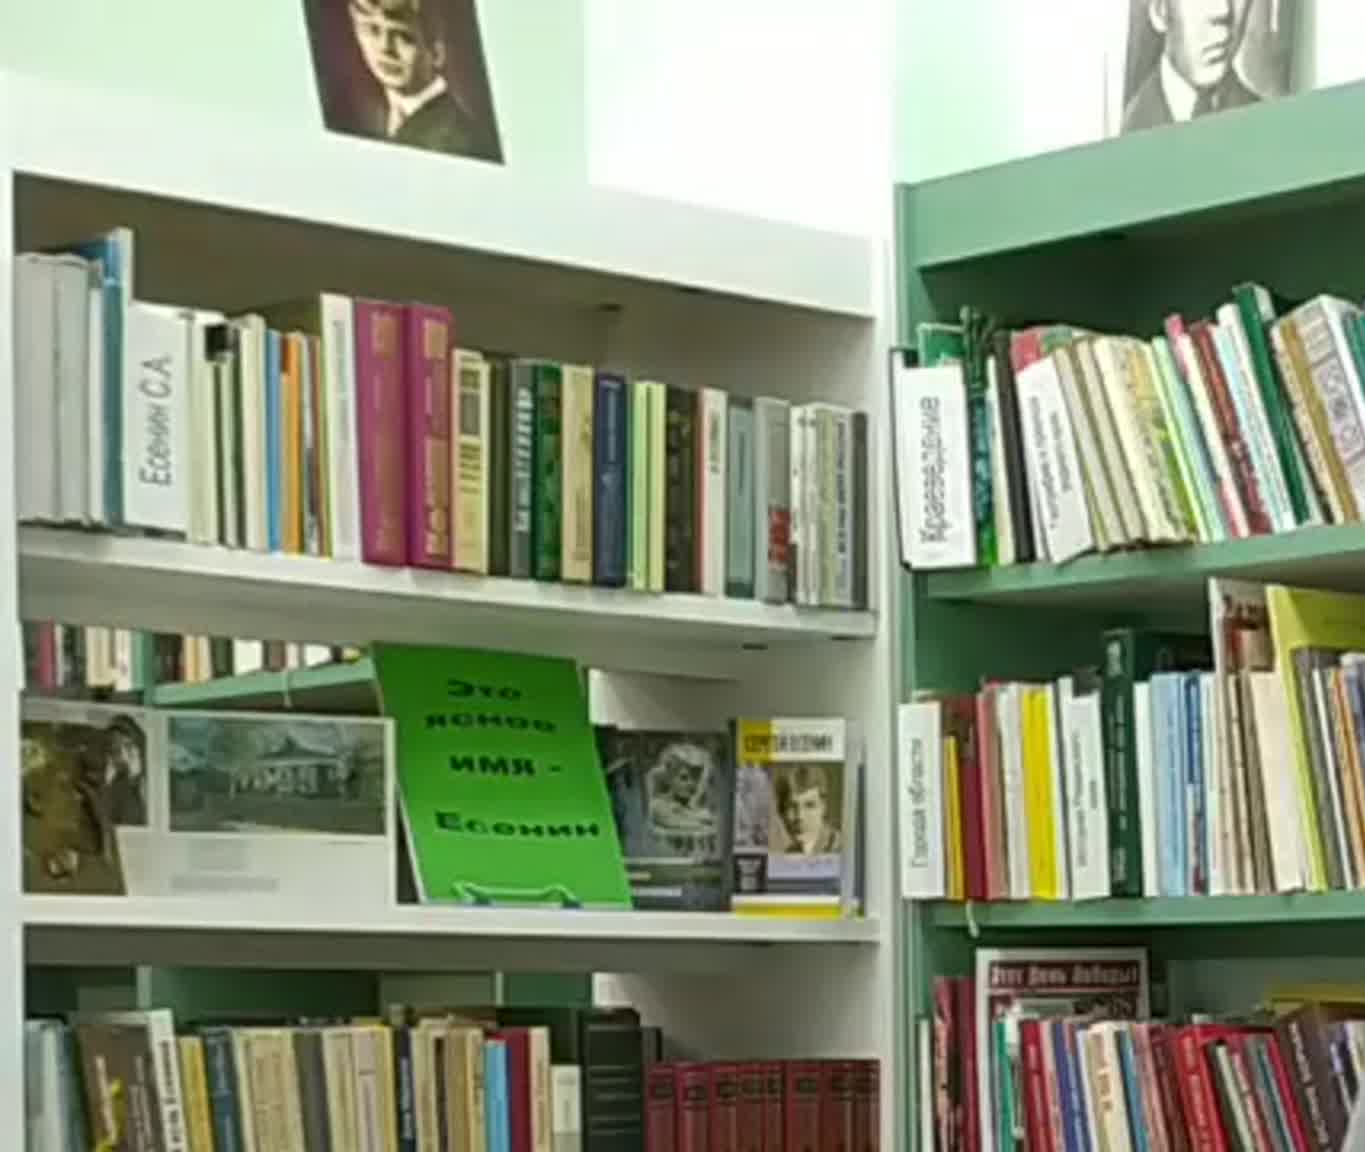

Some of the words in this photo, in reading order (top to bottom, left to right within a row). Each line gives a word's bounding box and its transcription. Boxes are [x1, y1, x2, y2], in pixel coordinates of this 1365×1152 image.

[138, 404, 172, 487] Есенин
[919, 396, 947, 543] Краеведение
[447, 679, 522, 700] Это
[450, 755, 536, 776] имя
[435, 810, 599, 837] Есенин
